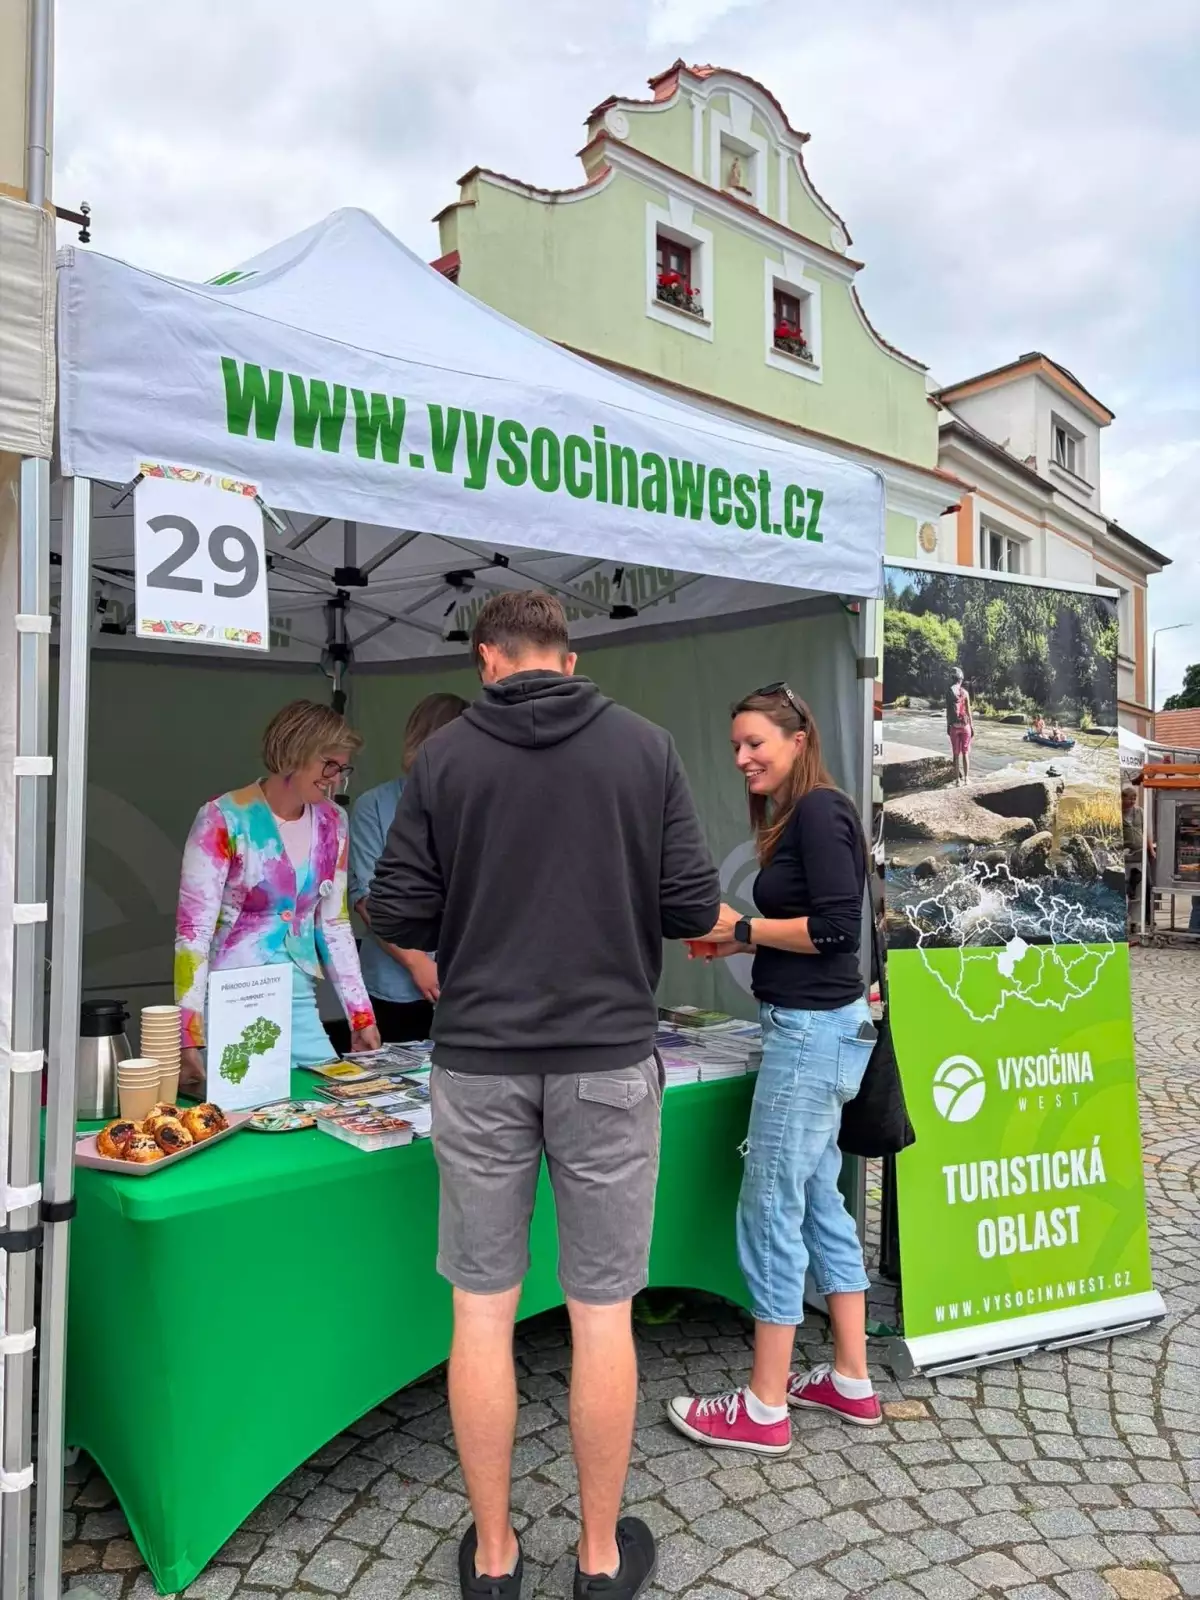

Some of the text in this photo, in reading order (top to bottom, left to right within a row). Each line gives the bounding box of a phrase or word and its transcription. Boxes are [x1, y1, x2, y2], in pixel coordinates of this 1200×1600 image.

[221, 356, 824, 543] www.vysocinawest.cz
[146, 514, 260, 599] 29
[997, 1047, 1094, 1090] VYSOČINA
[1018, 1092, 1080, 1112] WEST
[942, 1135, 1107, 1205] TURISTICKÁ
[977, 1205, 1081, 1260] OBLAST
[935, 1271, 1132, 1322] WWW.VYSOCINAWEST.CZ
